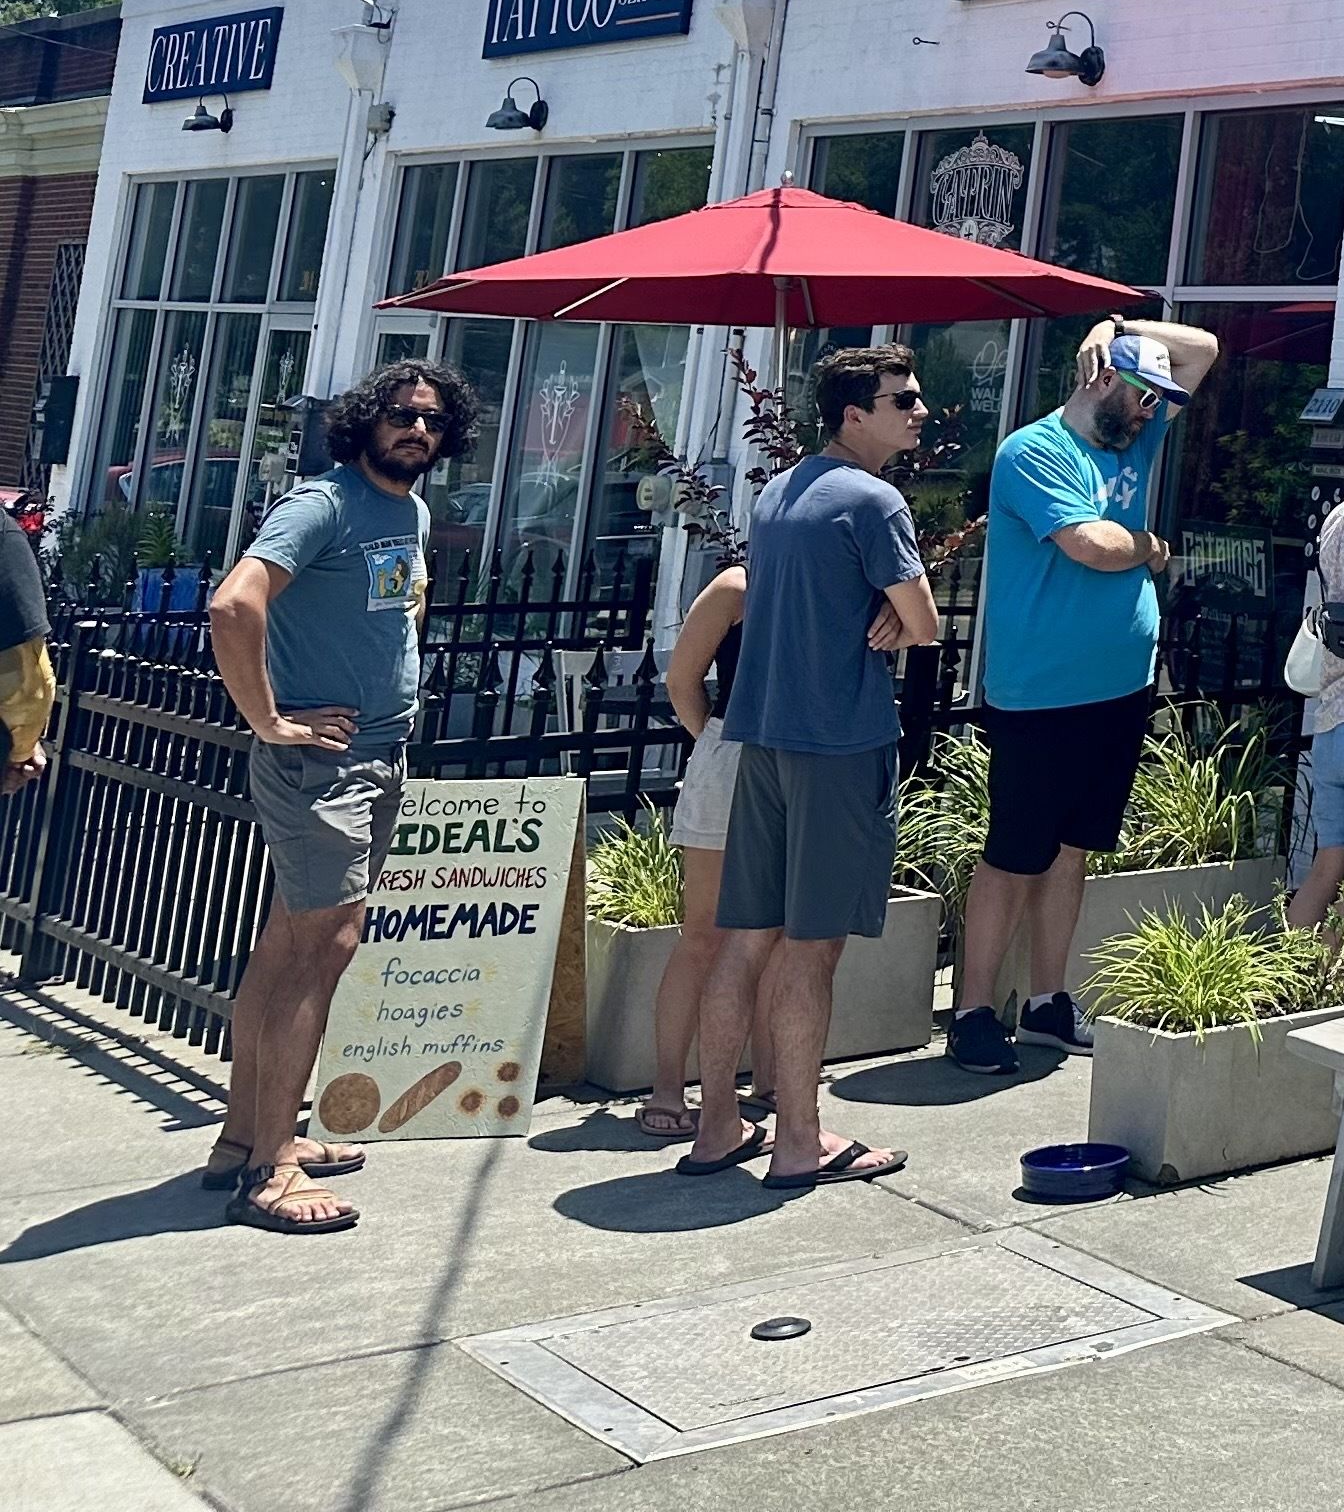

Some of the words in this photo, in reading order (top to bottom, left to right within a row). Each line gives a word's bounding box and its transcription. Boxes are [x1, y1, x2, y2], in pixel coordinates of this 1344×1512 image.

[147, 18, 273, 93] CREATIVE
[400, 787, 500, 817] elcome
[514, 784, 547, 815] to
[388, 817, 544, 856] IDEAL'S
[377, 867, 427, 892] RESH
[431, 866, 548, 889] SANDWICHES
[360, 901, 541, 944] HOMEMADE
[380, 957, 481, 987] focaccia
[376, 1000, 464, 1028] hoagies
[342, 1036, 412, 1063] english
[421, 1034, 506, 1056] muffins
